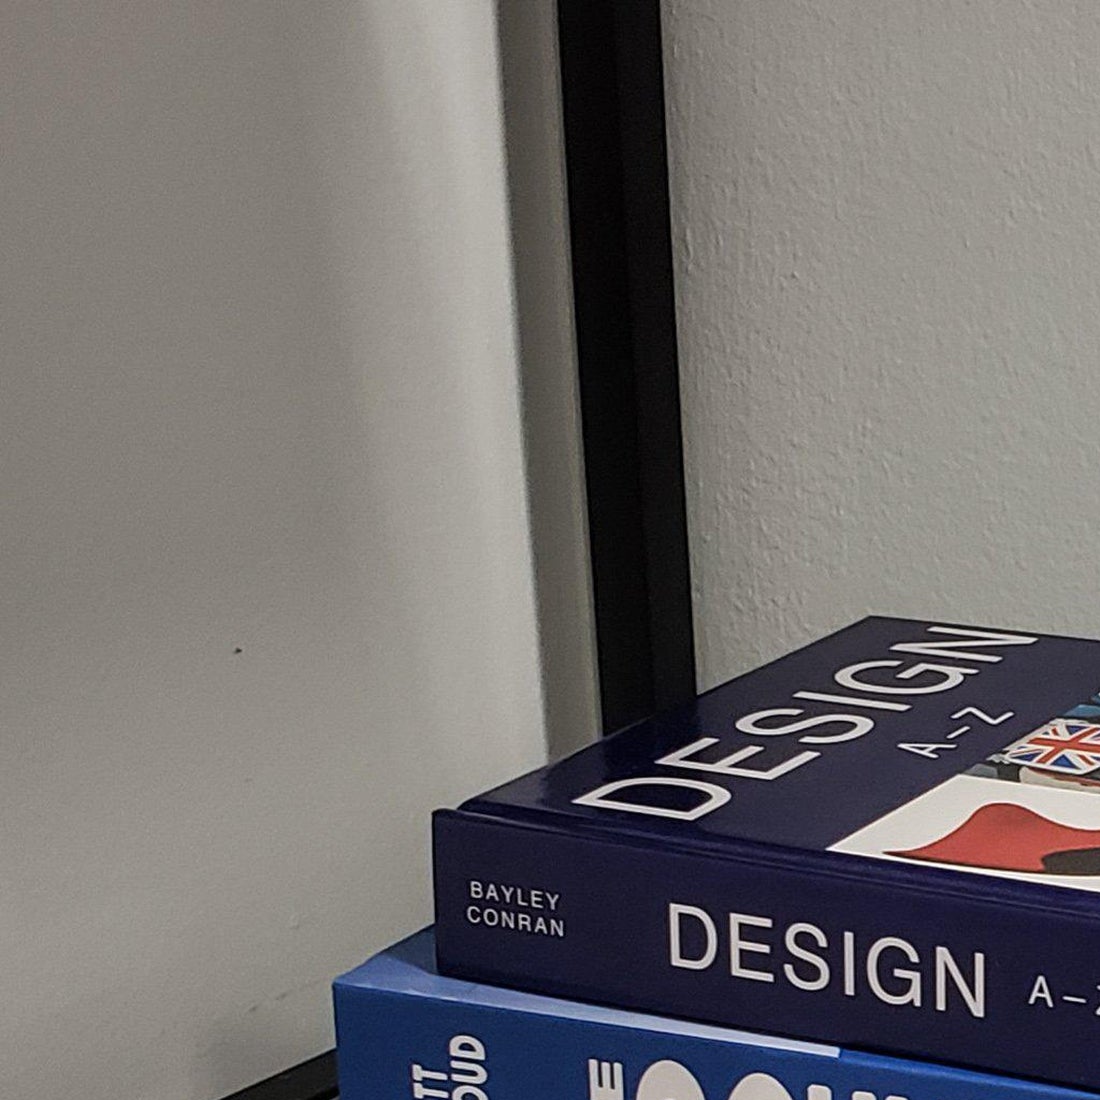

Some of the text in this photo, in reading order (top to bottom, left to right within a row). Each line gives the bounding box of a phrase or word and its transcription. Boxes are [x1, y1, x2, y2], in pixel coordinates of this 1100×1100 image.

[572, 626, 1038, 821] DESIGN
[466, 905, 565, 937] CONRAN
[469, 881, 560, 911] BAYLEY
[668, 902, 986, 1018] DESIGN
